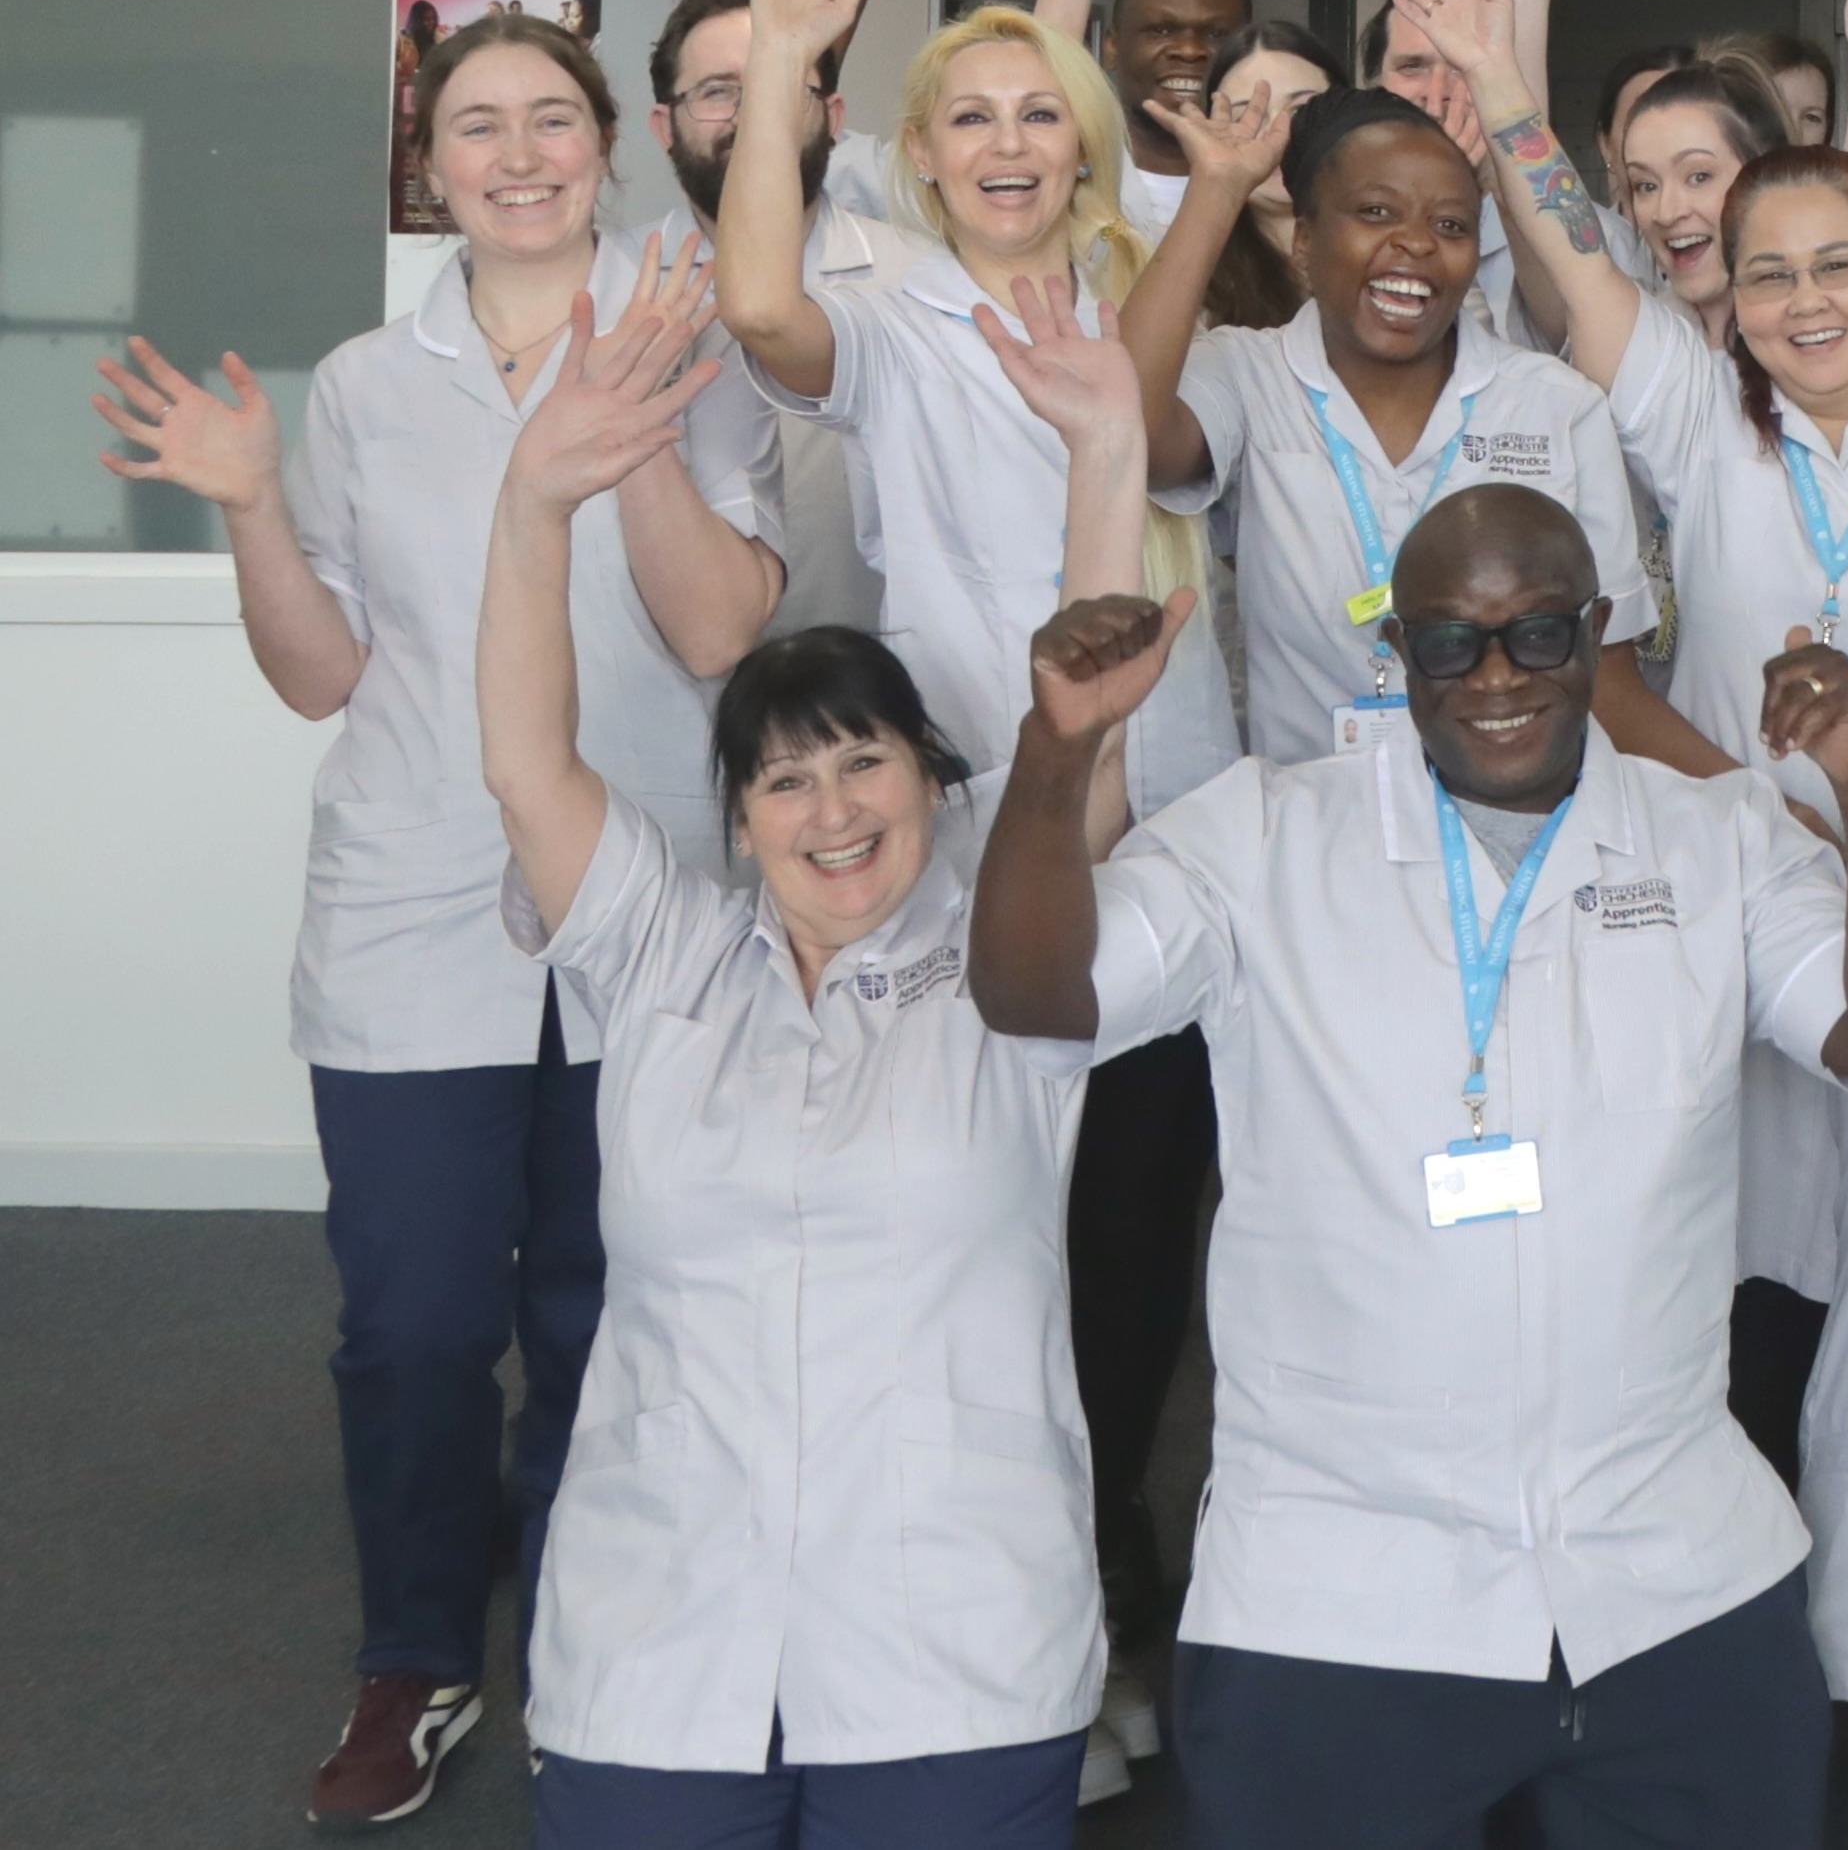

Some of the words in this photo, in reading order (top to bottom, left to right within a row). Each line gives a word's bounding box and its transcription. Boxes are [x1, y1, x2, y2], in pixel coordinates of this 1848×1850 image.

[1490, 455, 1550, 467] Apprentice
[1340, 453, 1361, 500] NURSING
[1357, 502, 1377, 547] STUDENT
[1453, 859, 1468, 911] NURSING
[1602, 903, 1676, 920] Apprentice
[1460, 912, 1477, 965] STUDENT
[1488, 913, 1514, 966] NURSING
